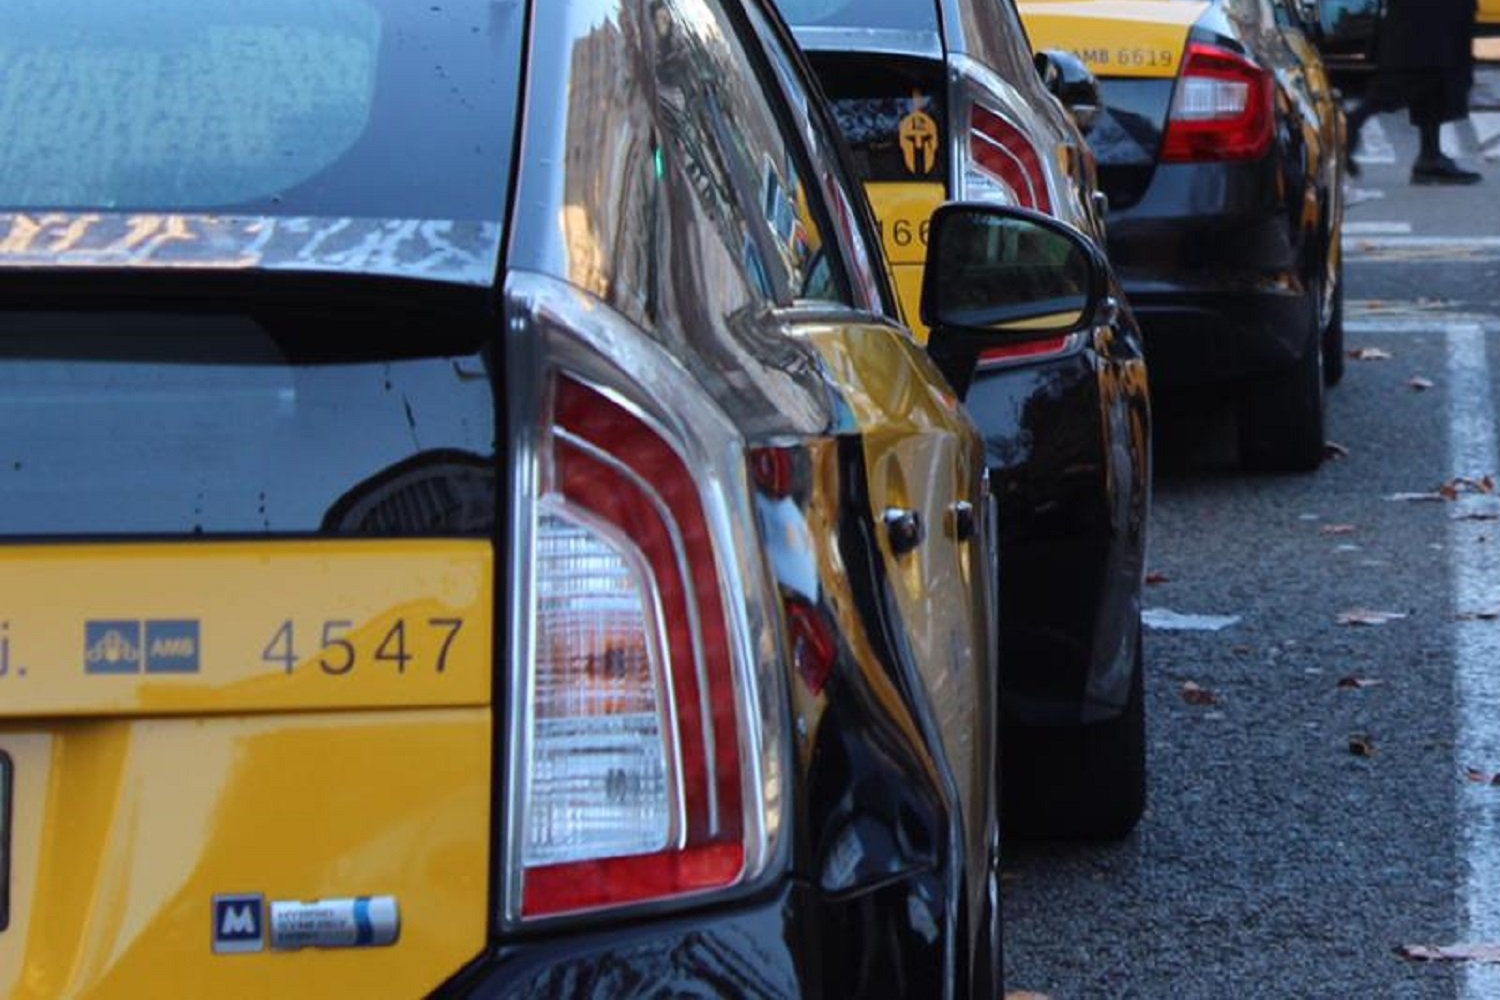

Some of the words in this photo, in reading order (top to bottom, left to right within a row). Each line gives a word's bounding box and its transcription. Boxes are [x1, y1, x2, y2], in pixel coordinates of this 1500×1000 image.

[1117, 50, 1173, 67] 6619
[151, 638, 195, 657] AMB
[261, 618, 464, 675] 4547
